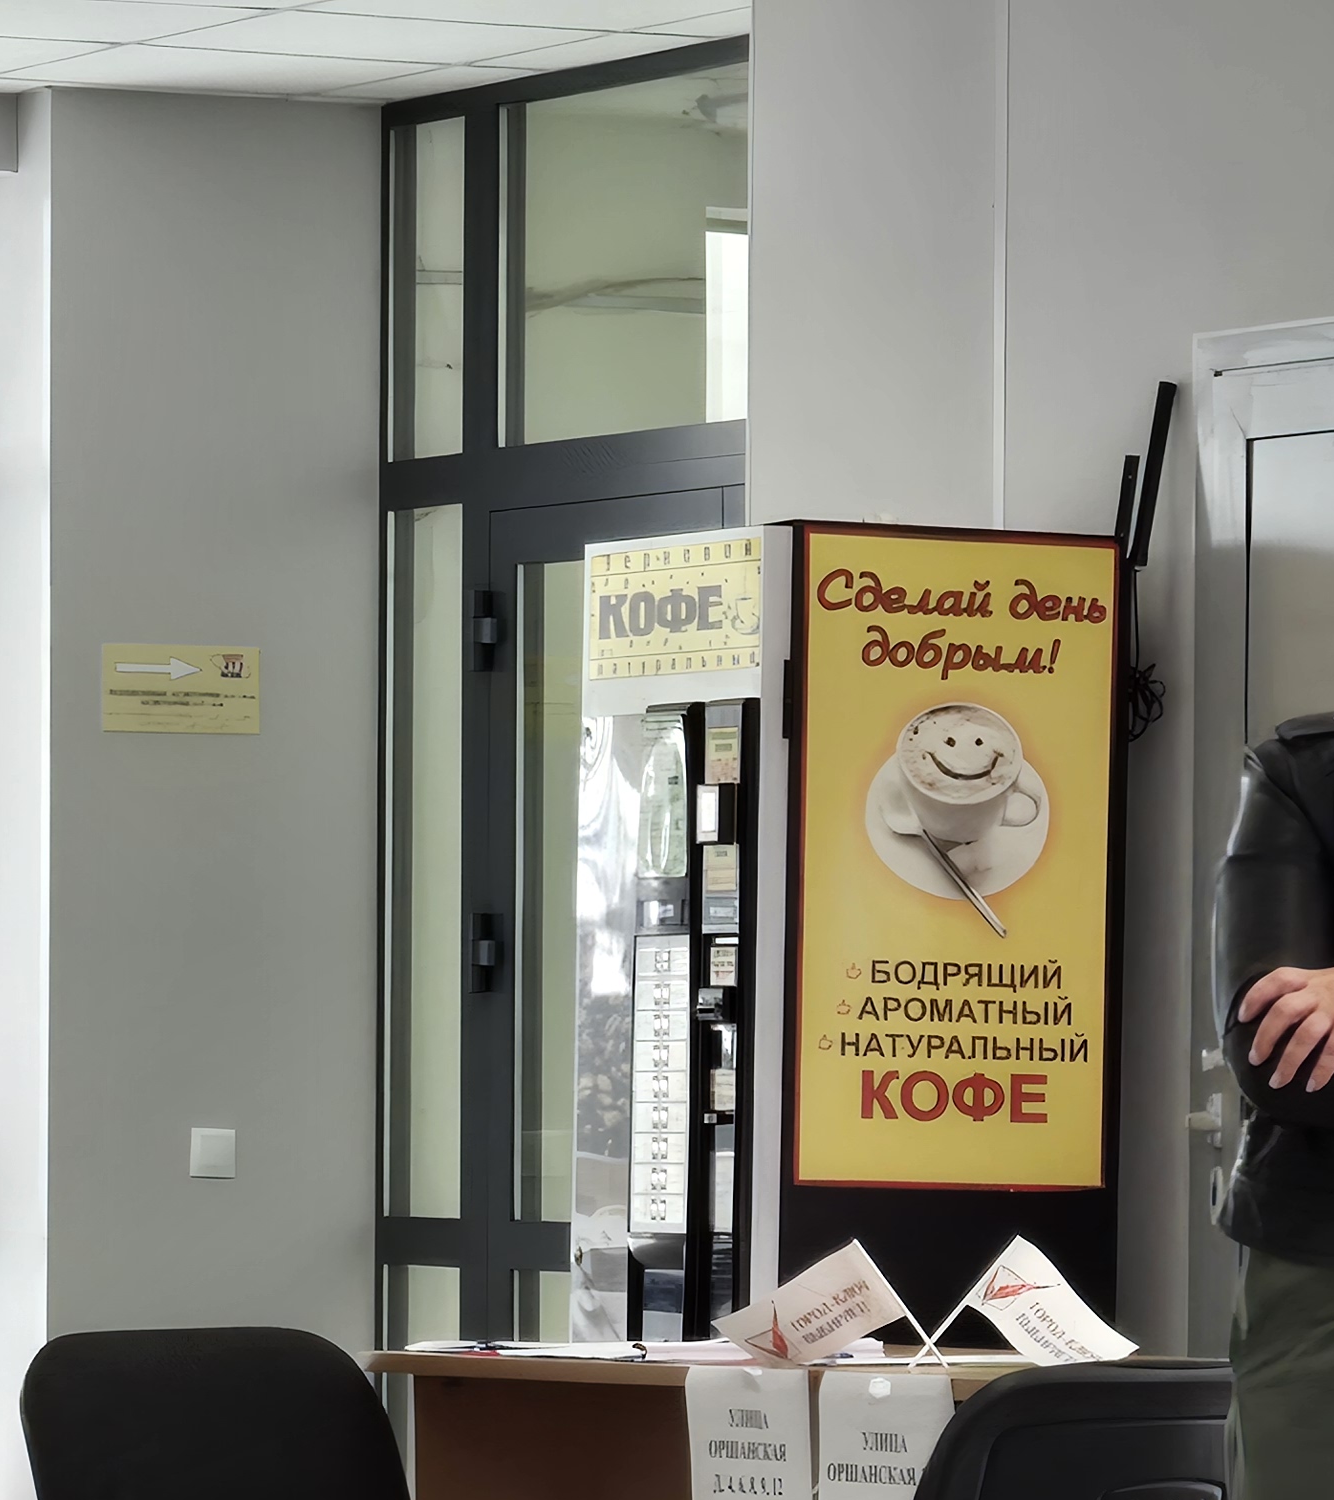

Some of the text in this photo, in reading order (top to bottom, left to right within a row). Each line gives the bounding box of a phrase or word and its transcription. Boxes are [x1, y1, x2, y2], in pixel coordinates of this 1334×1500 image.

[598, 584, 724, 640] КОФЕ
[816, 567, 994, 618] Сделай
[1008, 578, 1107, 625] день
[861, 624, 1062, 681] добрым!
[870, 958, 1063, 993] БОДРЯЩИЙ
[856, 995, 1074, 1027] АРОМАТНЫЙ
[839, 1031, 1090, 1064] НАТУРАЛЬНЫЙ
[860, 1069, 1049, 1124] КОФЕ
[728, 1408, 770, 1431] УЛИЦА
[708, 1439, 788, 1463] ОРШАНСКАЯ
[861, 1431, 909, 1454] УЛИЦА
[827, 1462, 917, 1487] ОРШАНСКАЯ
